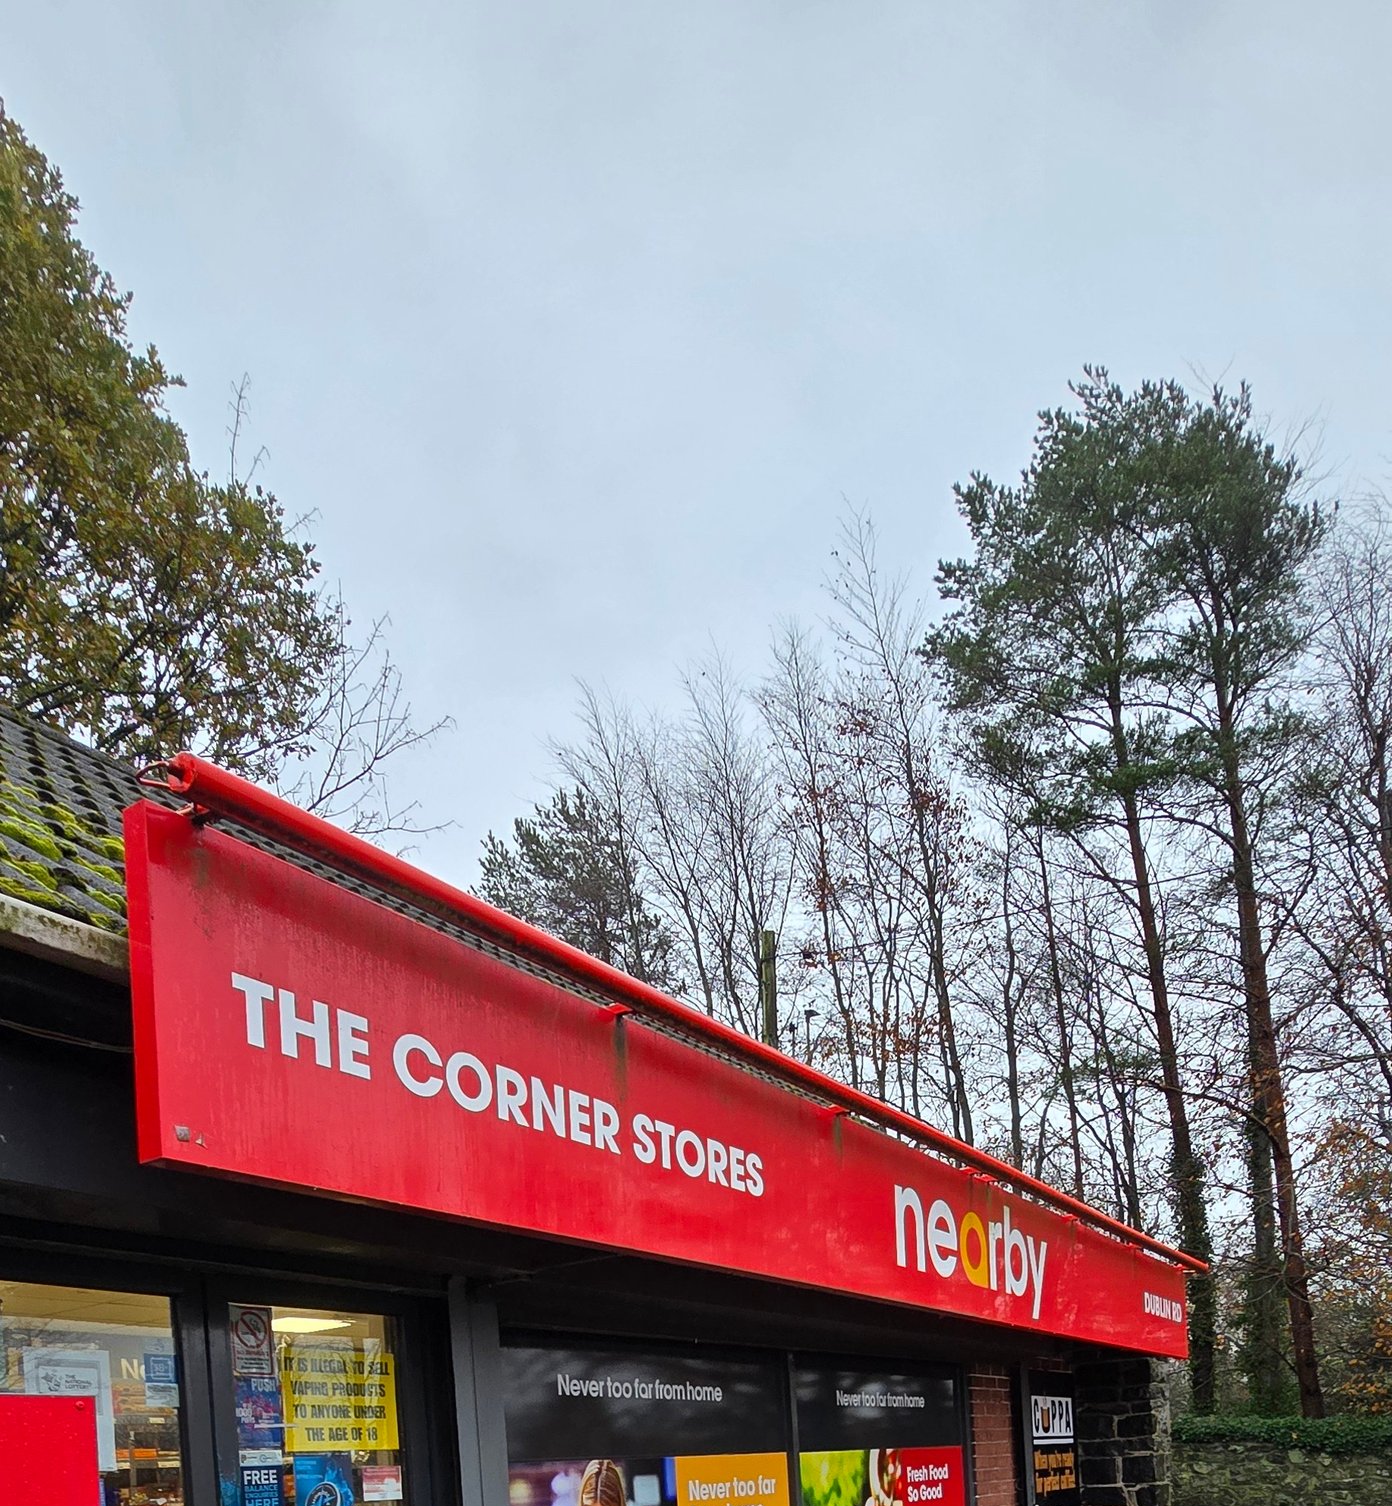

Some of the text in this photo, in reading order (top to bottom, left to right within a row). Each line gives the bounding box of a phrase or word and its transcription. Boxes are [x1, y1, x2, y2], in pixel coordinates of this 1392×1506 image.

[231, 972, 764, 1197] THE CORNER STORES
[894, 1184, 1048, 1320] nearby
[1144, 1292, 1182, 1323] DUBLIN RD
[297, 1357, 308, 1371] IS
[310, 1357, 347, 1375] ILLEGAL
[353, 1361, 364, 1375] TO
[368, 1361, 390, 1376] SELL
[251, 1379, 277, 1392] PUSH
[291, 1381, 386, 1397] VAPING PRODUCTS
[557, 1374, 722, 1401] Never too far from home
[836, 1390, 925, 1408] Never too far from home
[294, 1404, 307, 1418] TO
[311, 1404, 351, 1419] ANYONE
[354, 1405, 386, 1419] UNDER
[1034, 1397, 1072, 1434] CUPPA
[305, 1427, 378, 1441] THE AGE OF 18
[243, 1469, 278, 1485] FREE
[907, 1463, 949, 1482] Fresh Food
[688, 1475, 776, 1501] Never too far
[908, 1482, 943, 1502] So Good
